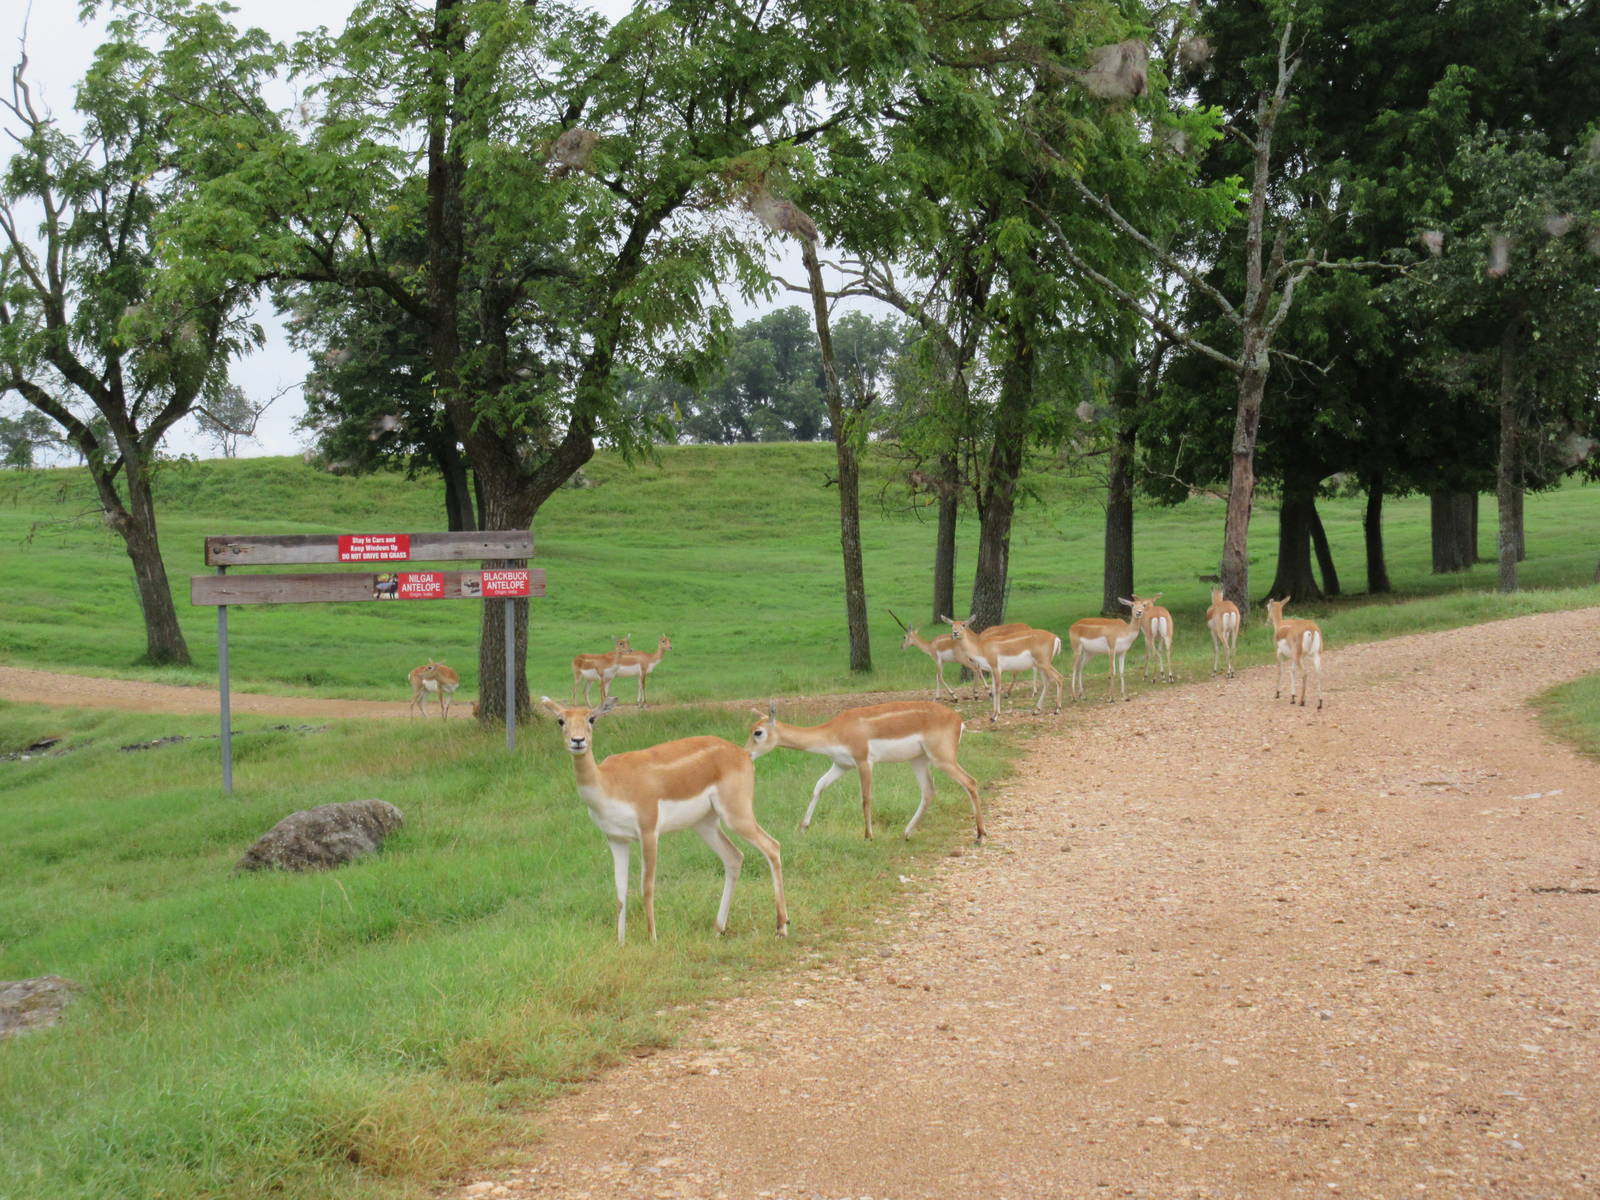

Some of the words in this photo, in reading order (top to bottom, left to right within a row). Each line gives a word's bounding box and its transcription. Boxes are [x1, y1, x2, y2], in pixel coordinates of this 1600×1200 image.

[408, 574, 434, 582] NILGAI
[484, 572, 528, 580] BLACKBUCK
[402, 582, 440, 592] ANTELOPE
[487, 581, 524, 590] ANTELOPE
